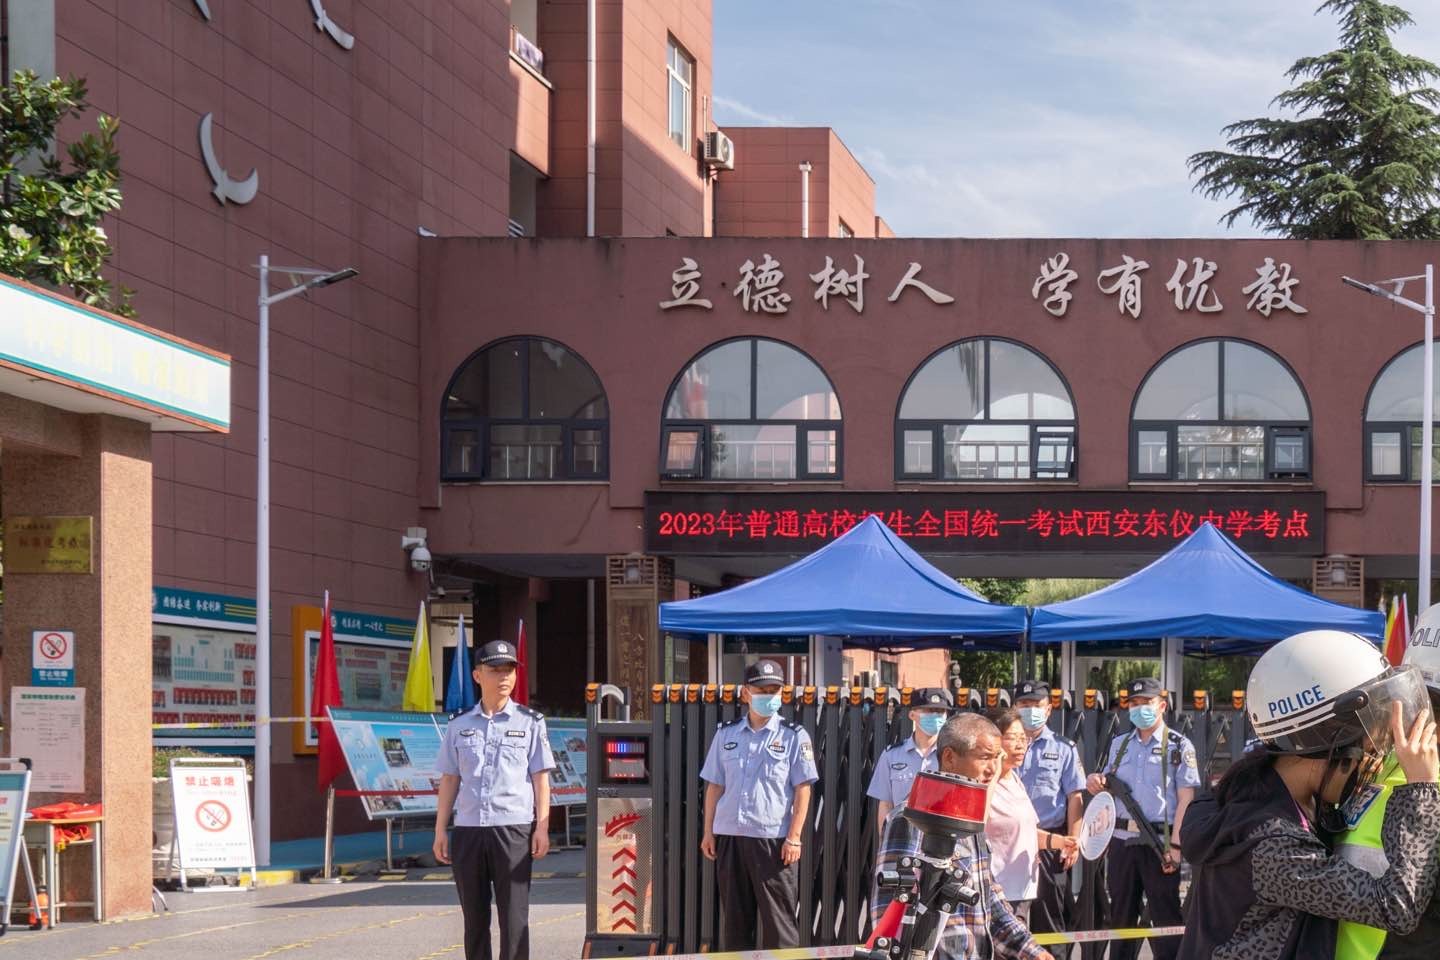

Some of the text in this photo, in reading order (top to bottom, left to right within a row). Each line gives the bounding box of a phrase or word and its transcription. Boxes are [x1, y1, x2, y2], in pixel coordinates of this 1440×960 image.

[659, 251, 1309, 319] 立德树人 学有优教
[659, 508, 1310, 539] 2023年普通高校生全国统一考试西安东仪中学考点
[1268, 684, 1326, 719] POLICE
